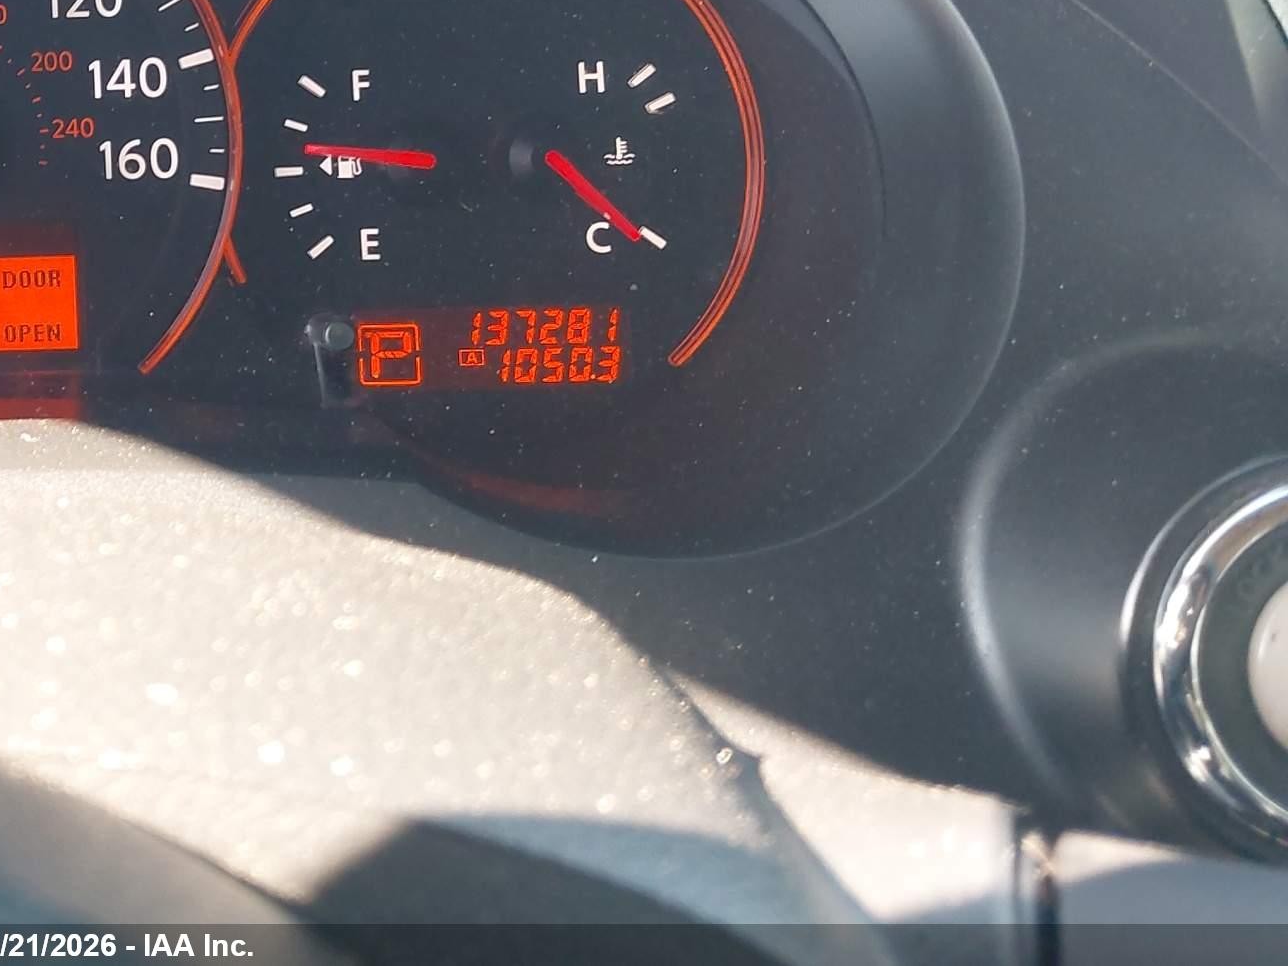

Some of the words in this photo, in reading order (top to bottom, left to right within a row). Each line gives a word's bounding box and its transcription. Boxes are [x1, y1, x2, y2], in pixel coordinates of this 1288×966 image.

[31, 50, 73, 73] 200
[88, 57, 168, 99] 140
[578, 60, 606, 94] H
[352, 69, 371, 102] F
[51, 117, 95, 140] 240
[99, 136, 179, 180] 160
[360, 228, 382, 262] E
[585, 221, 612, 255] C
[1, 269, 62, 289] DOOR
[3, 323, 62, 343] OPEN
[471, 308, 620, 346] 137281
[370, 330, 413, 379] P
